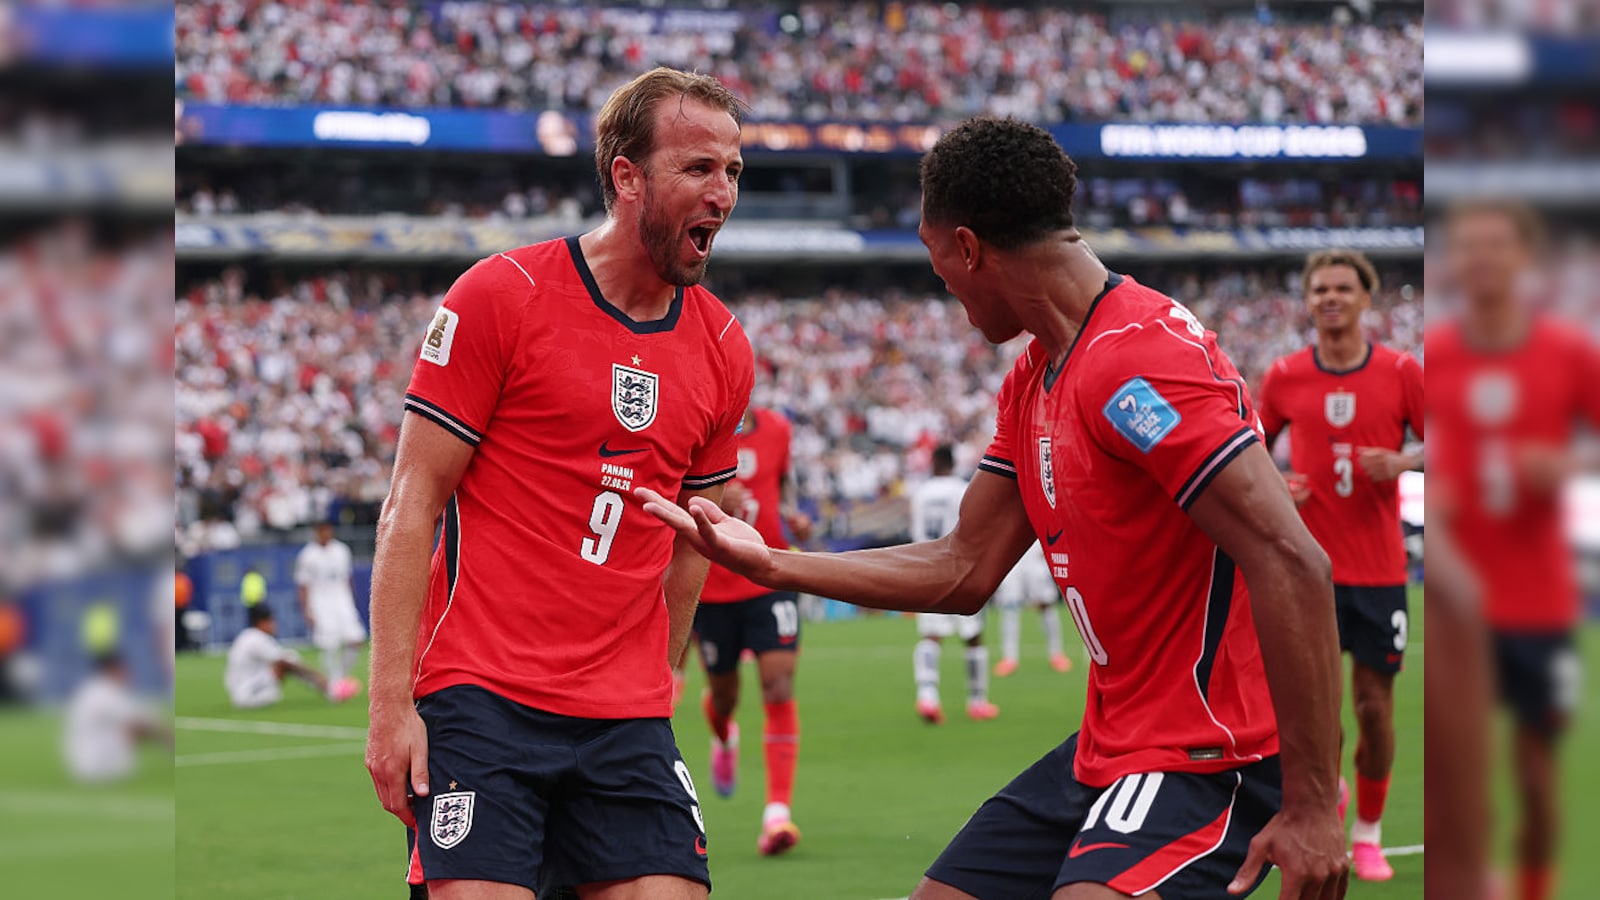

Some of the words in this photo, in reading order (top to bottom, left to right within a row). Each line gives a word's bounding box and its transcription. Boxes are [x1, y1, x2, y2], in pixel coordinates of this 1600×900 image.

[601, 463, 634, 480] PANAMA
[1333, 457, 1354, 497] 3
[580, 490, 625, 566] 9
[1065, 585, 1109, 667] 0
[1391, 609, 1408, 652] 3
[1080, 771, 1165, 834] 10
